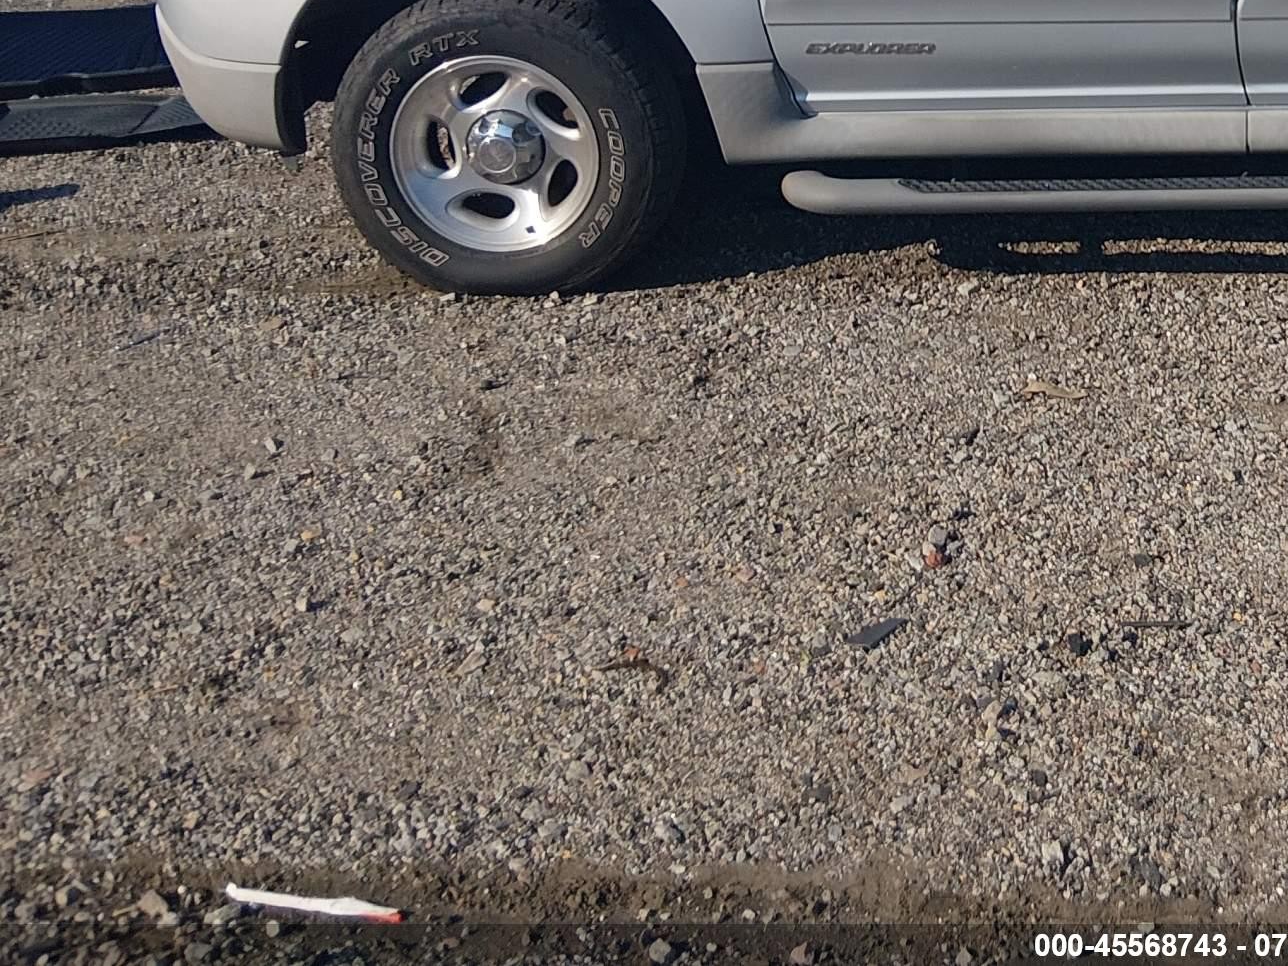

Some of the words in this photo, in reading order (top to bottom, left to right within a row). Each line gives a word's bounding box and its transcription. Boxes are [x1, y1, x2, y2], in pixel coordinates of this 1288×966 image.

[805, 42, 937, 55] EXPLORER
[357, 67, 450, 268] DISCOVERER
[408, 28, 481, 66] RTX
[578, 108, 627, 249] COOPER
